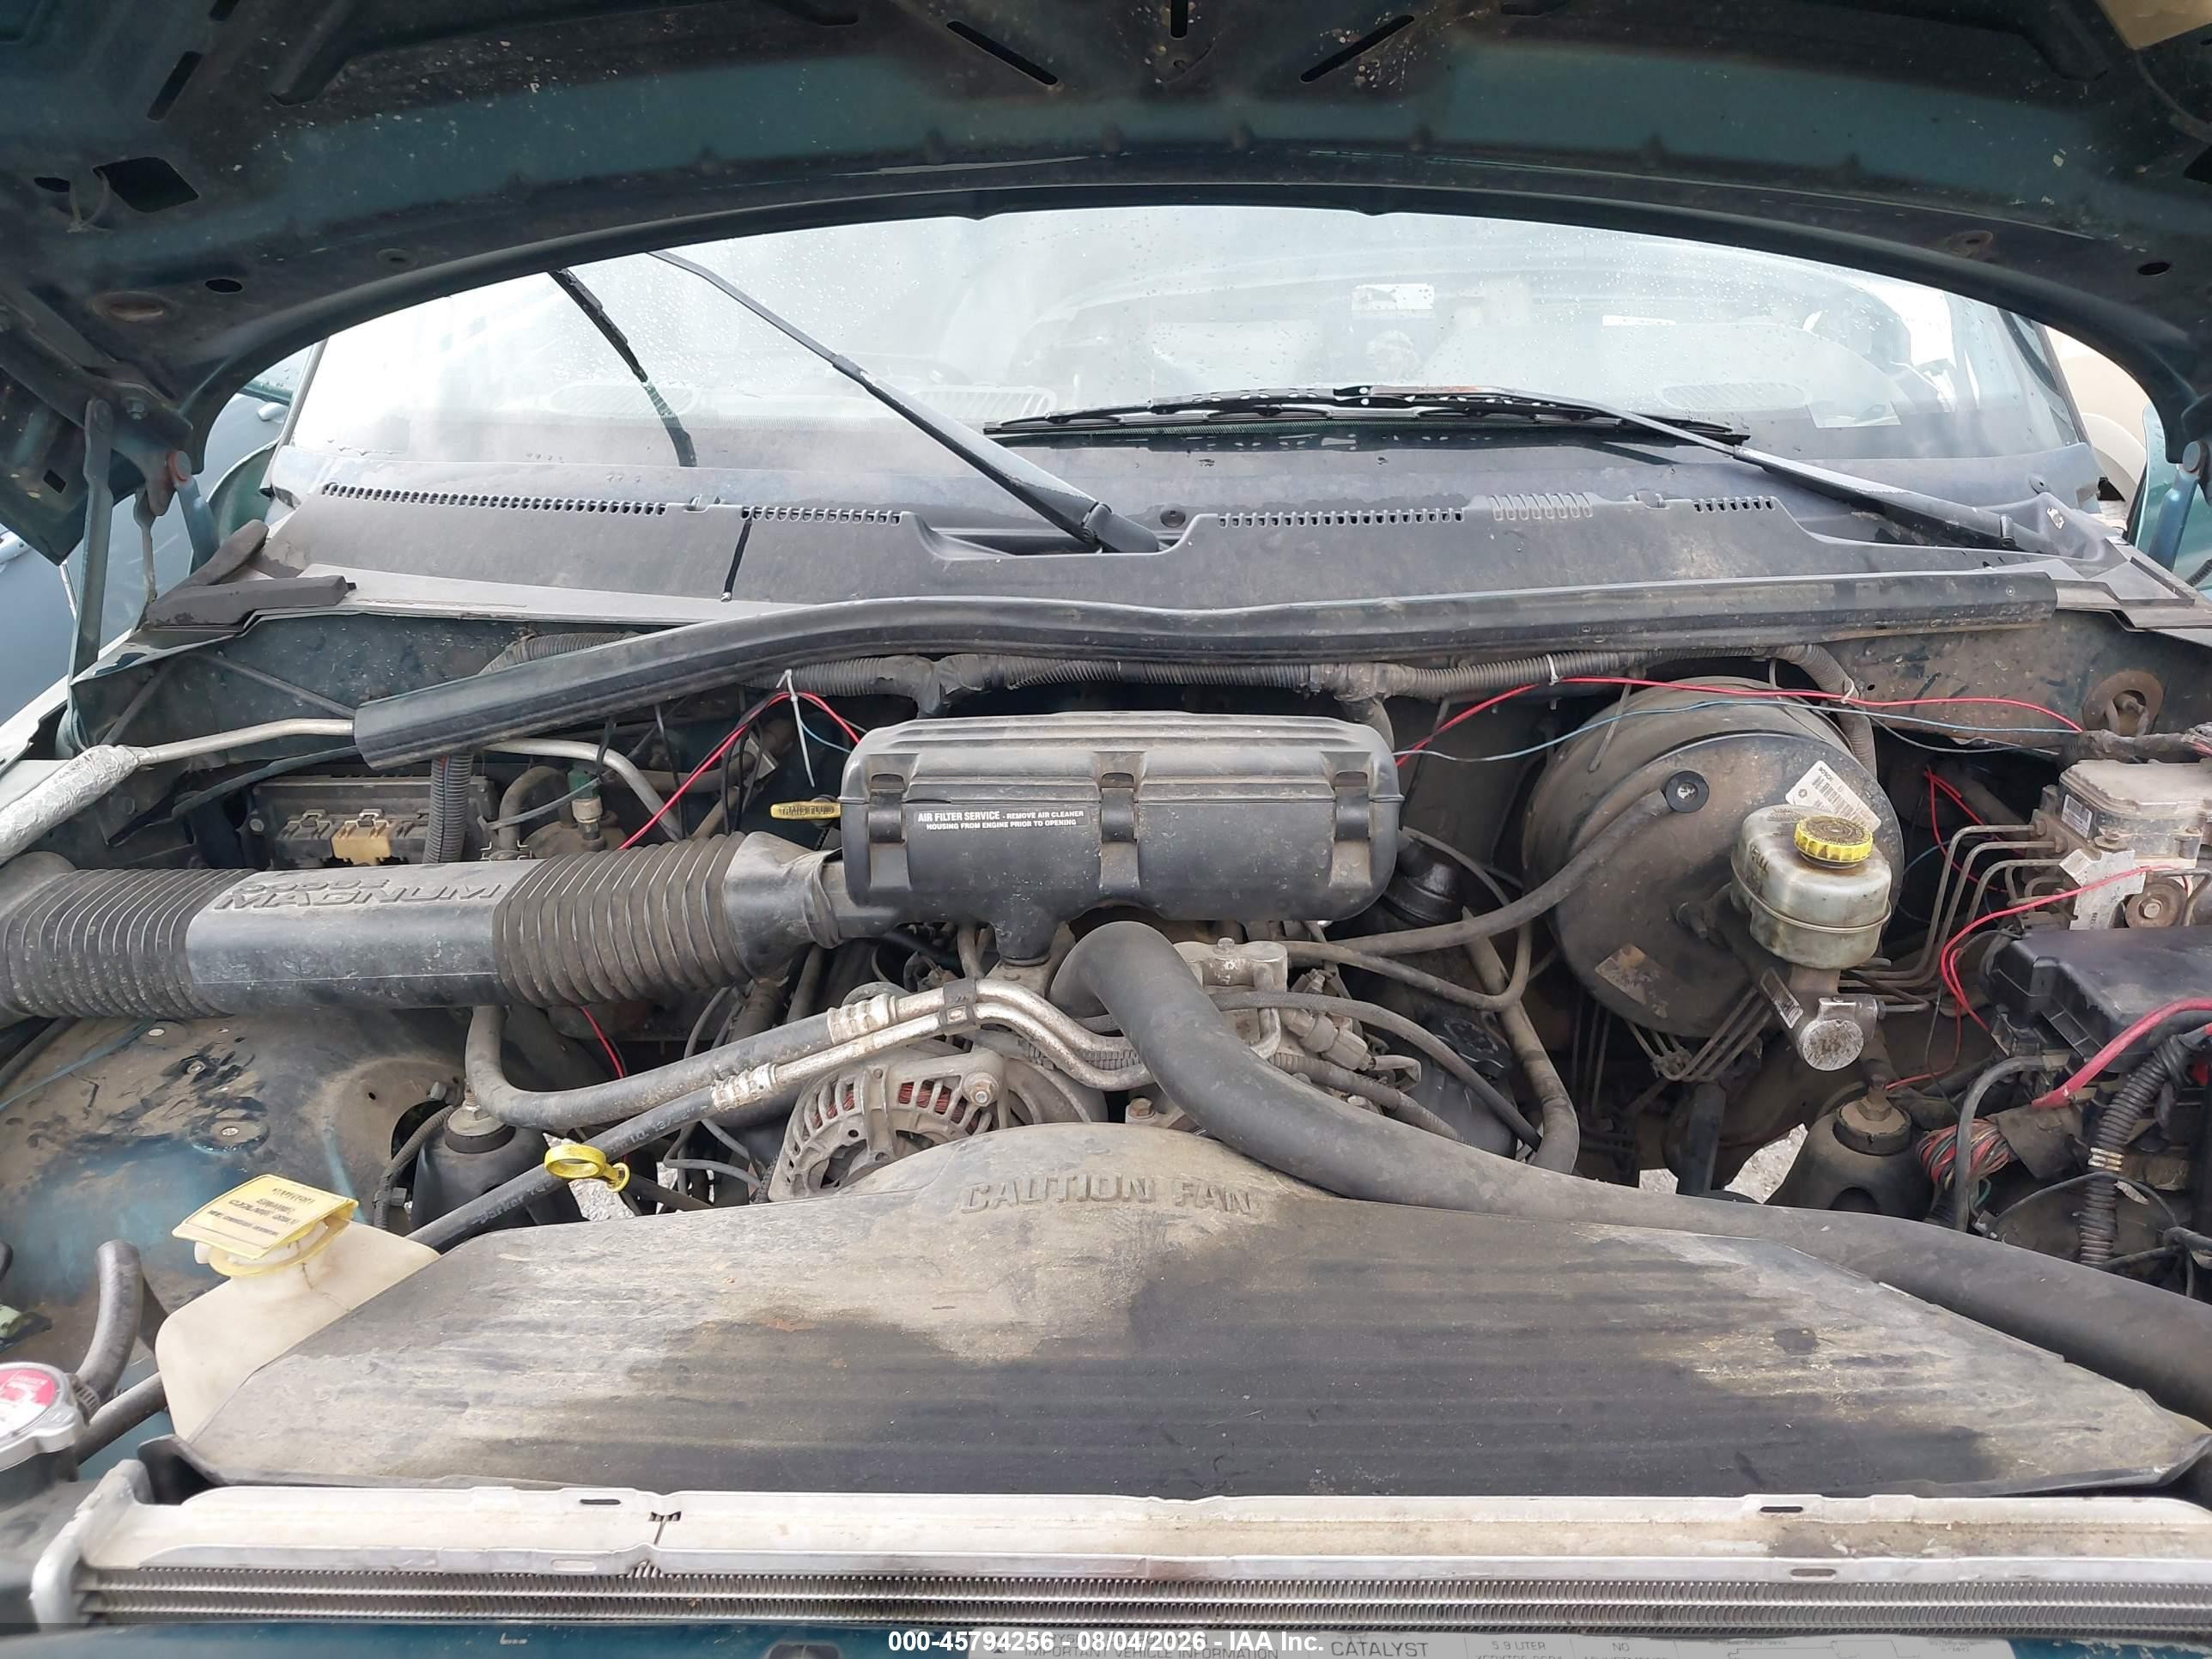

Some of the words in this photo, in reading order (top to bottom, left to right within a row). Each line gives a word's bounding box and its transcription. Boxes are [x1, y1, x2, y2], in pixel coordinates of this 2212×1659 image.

[918, 812, 933, 822] AIR
[935, 811, 963, 821] FILTER
[964, 811, 1000, 820] SERVICE
[213, 884, 503, 910] MAGNUM
[960, 1174, 1156, 1214] CAUTION
[1175, 1180, 1251, 1215] FAN
[1331, 1641, 1429, 1657] CATALYST
[1514, 1641, 1547, 1650] LITER
[1612, 1642, 1630, 1651] NO
